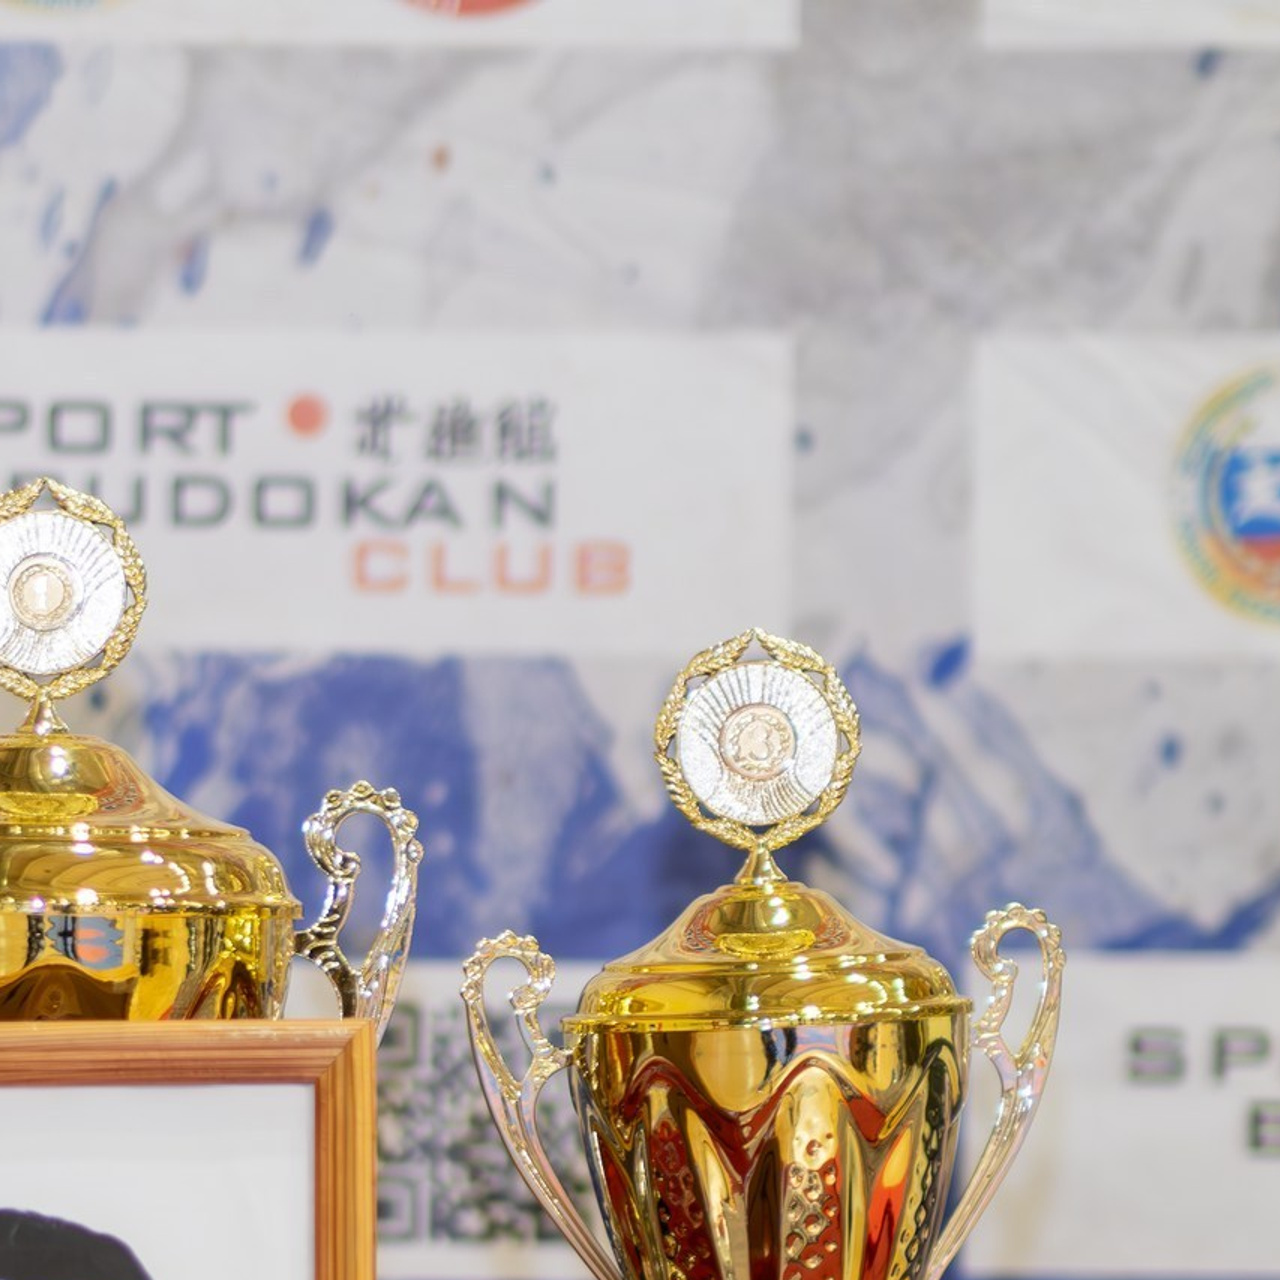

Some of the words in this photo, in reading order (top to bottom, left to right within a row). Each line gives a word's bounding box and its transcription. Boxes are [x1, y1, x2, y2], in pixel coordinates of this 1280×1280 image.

[8, 470, 556, 530] UDOKAN
[353, 541, 632, 594] CLUB
[748, 721, 773, 760] 3
